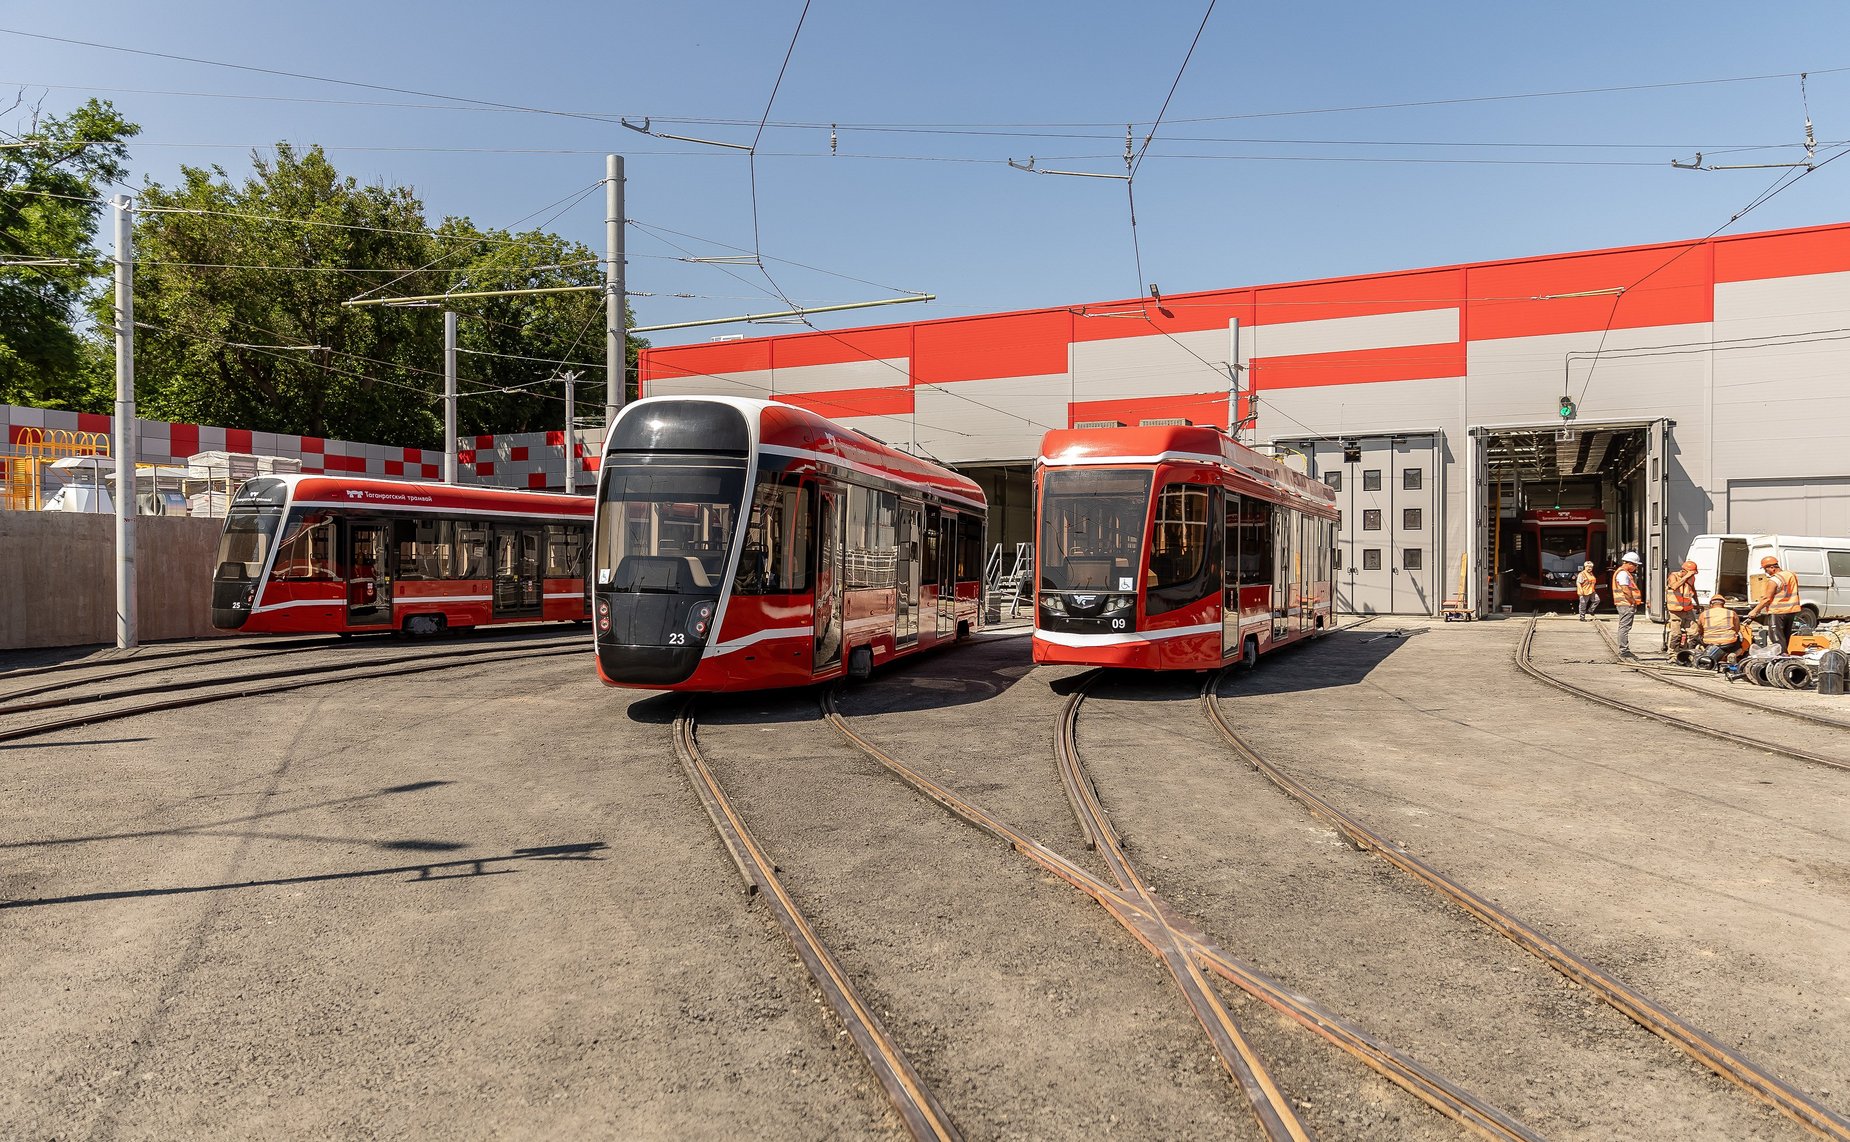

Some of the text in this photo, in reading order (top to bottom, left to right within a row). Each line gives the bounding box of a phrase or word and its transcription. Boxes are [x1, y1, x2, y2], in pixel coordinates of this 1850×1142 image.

[364, 491, 406, 500] Таганрогский
[1112, 618, 1126, 629] 09
[669, 633, 685, 645] 23
